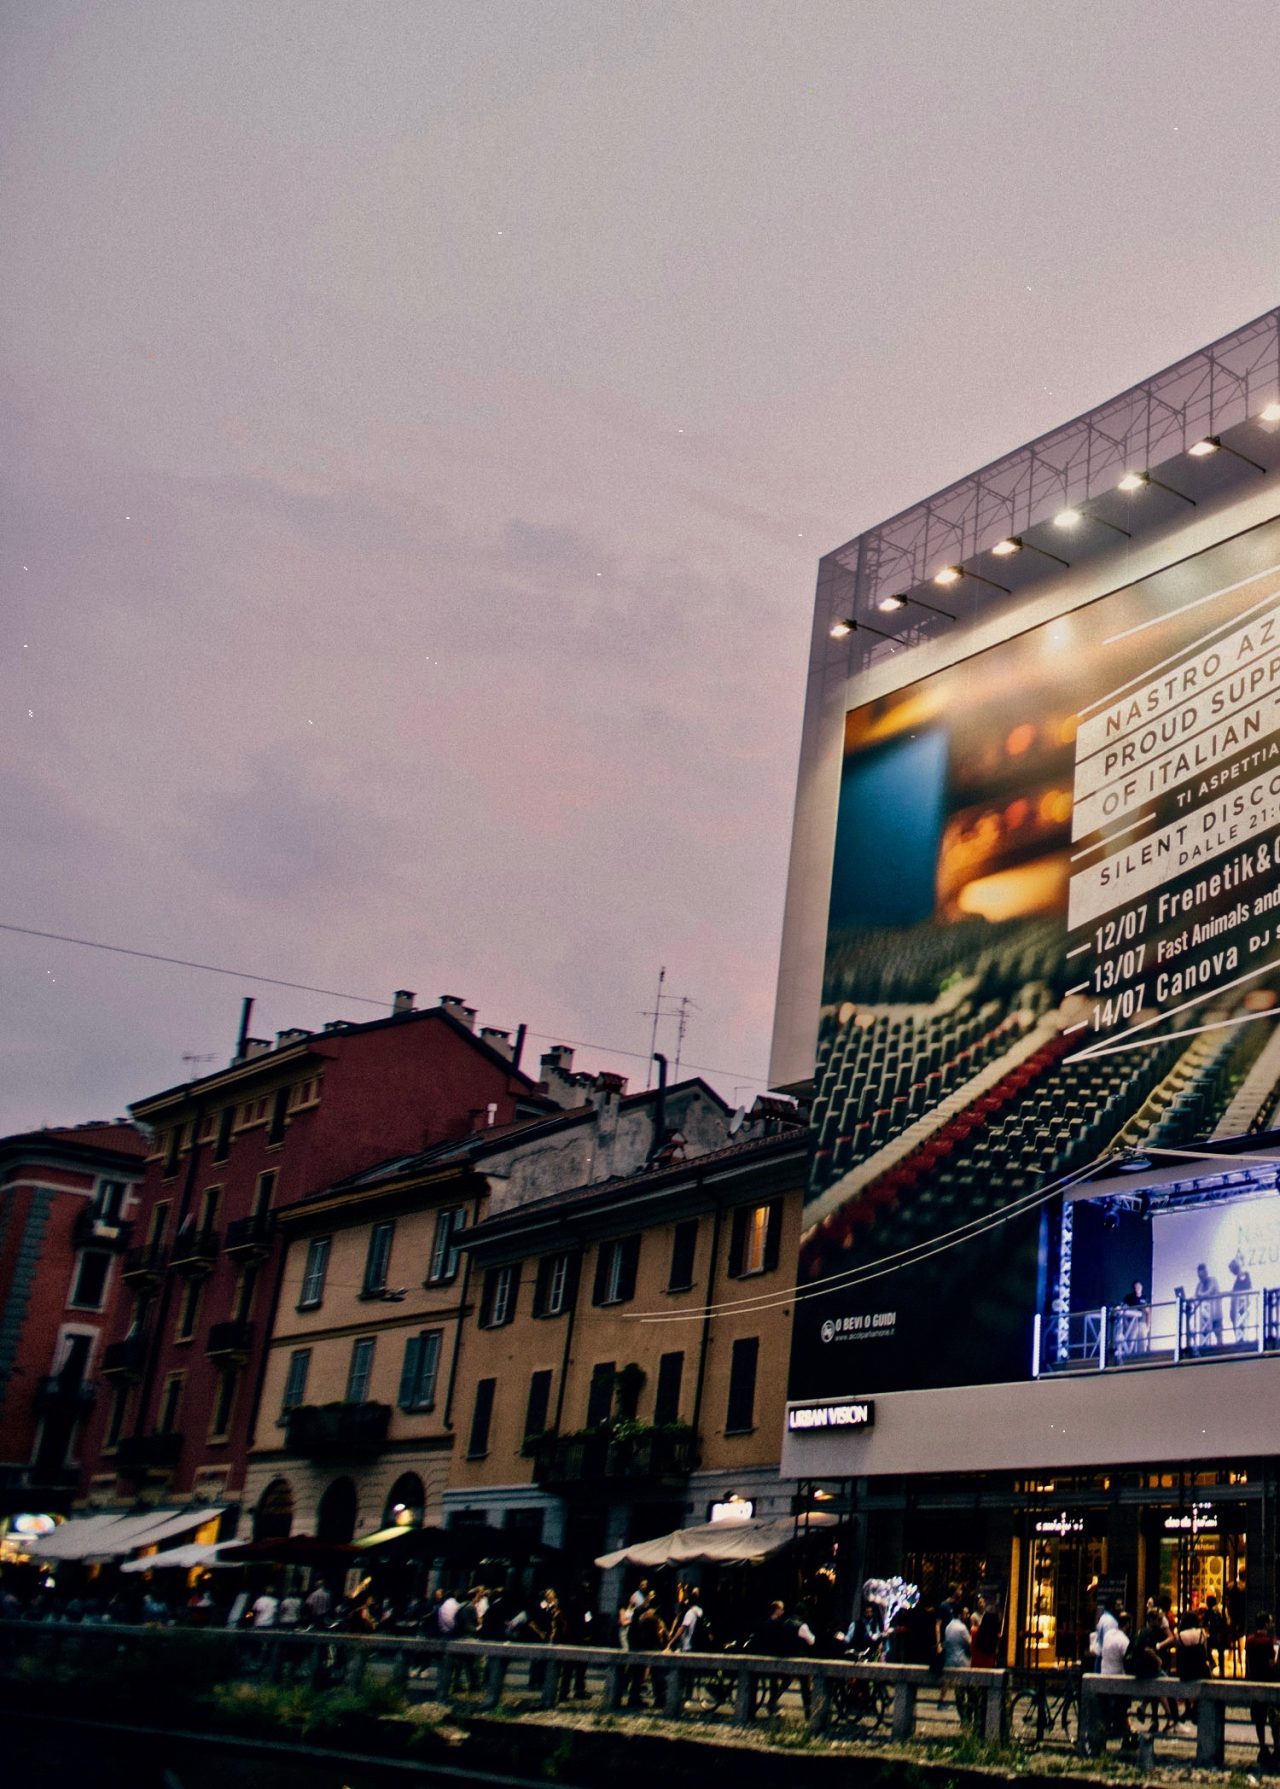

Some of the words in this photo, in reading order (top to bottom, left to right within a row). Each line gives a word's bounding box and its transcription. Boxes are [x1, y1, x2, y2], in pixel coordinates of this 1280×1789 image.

[1104, 653, 1221, 737] NASTRO
[1102, 784, 1136, 816] OF
[1149, 710, 1261, 791] ITALIAN
[1104, 708, 1198, 777] PROUD
[1177, 790, 1192, 808] TI
[1100, 825, 1188, 887] SILENT
[1178, 823, 1239, 866] DALLE
[1094, 944, 1146, 993] 13/07
[1157, 931, 1189, 964] Fast
[1191, 905, 1250, 953] Animals
[1095, 905, 1148, 954] 12/07
[1092, 983, 1145, 1033] 14/07
[1156, 945, 1239, 1003] Canova
[1248, 927, 1270, 953] DJ
[843, 1315, 864, 1331] BEVI
[790, 1407, 828, 1428] URBAN
[828, 1405, 868, 1425] VISION
